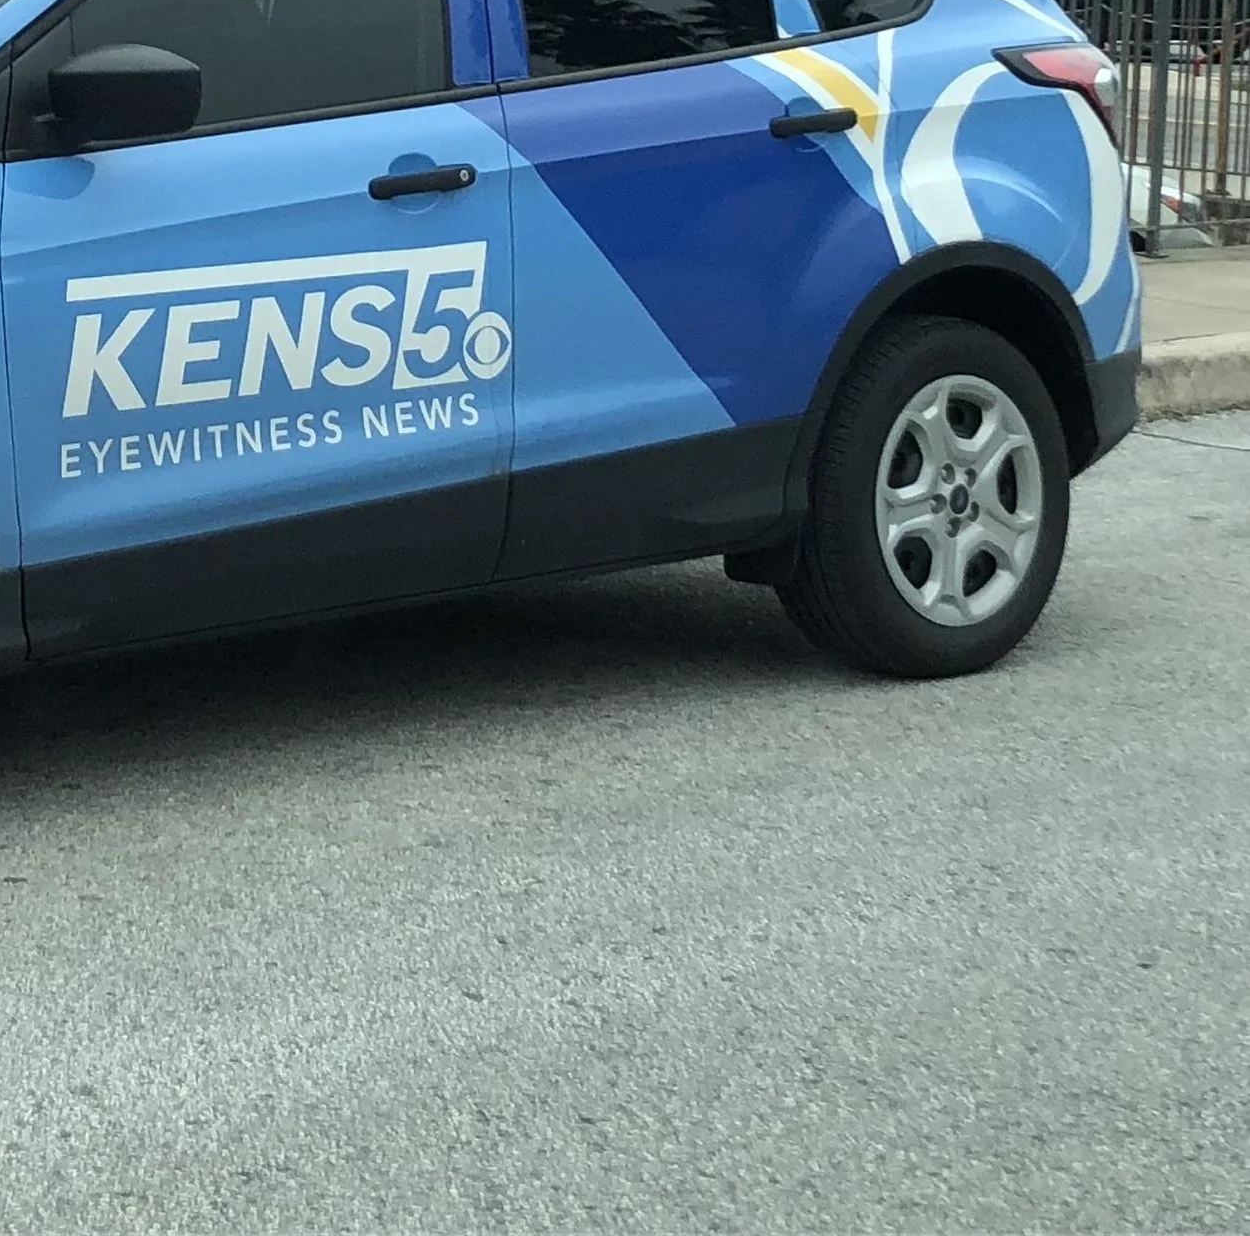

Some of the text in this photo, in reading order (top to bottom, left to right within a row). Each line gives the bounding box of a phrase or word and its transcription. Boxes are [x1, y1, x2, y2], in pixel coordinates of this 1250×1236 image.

[62, 284, 397, 417] KENS
[60, 392, 480, 479] EYEWITNESS NEWS
